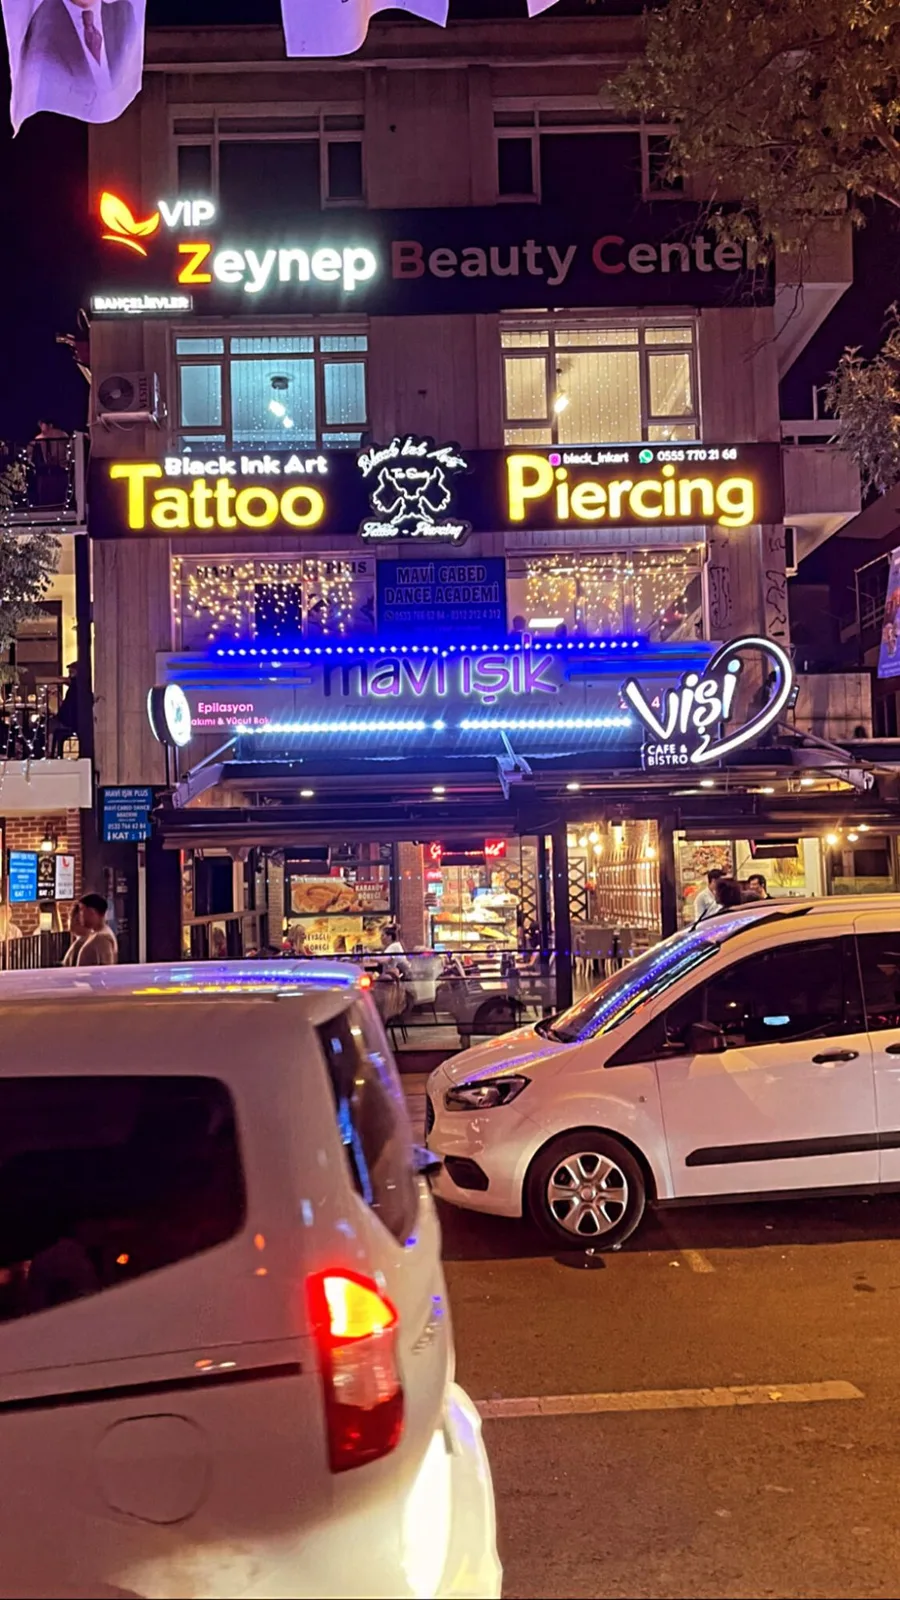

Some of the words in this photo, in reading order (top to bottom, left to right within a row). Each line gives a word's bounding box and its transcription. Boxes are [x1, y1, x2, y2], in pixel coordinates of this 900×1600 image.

[158, 201, 215, 227] VIP
[178, 244, 377, 293] Zeynep
[391, 240, 577, 285] Beauty
[657, 450, 685, 461] 0555
[687, 449, 707, 460] 770
[165, 457, 236, 475] Black
[241, 456, 280, 474] Ink
[284, 455, 328, 473] Art
[110, 464, 324, 529] Tattoo
[506, 454, 754, 527] Piercing
[396, 562, 435, 584] MAVİ
[438, 565, 487, 583] CABED
[384, 586, 432, 605] DANCE
[434, 581, 500, 604] ACADEMİ
[197, 702, 254, 714] Epilasyon
[191, 717, 216, 726] akımı
[217, 718, 225, 726] &
[647, 744, 676, 755] CAFE
[680, 744, 688, 753] &
[648, 754, 689, 766] BISTRO
[134, 789, 148, 797] PLUS
[112, 832, 129, 840] KAT
